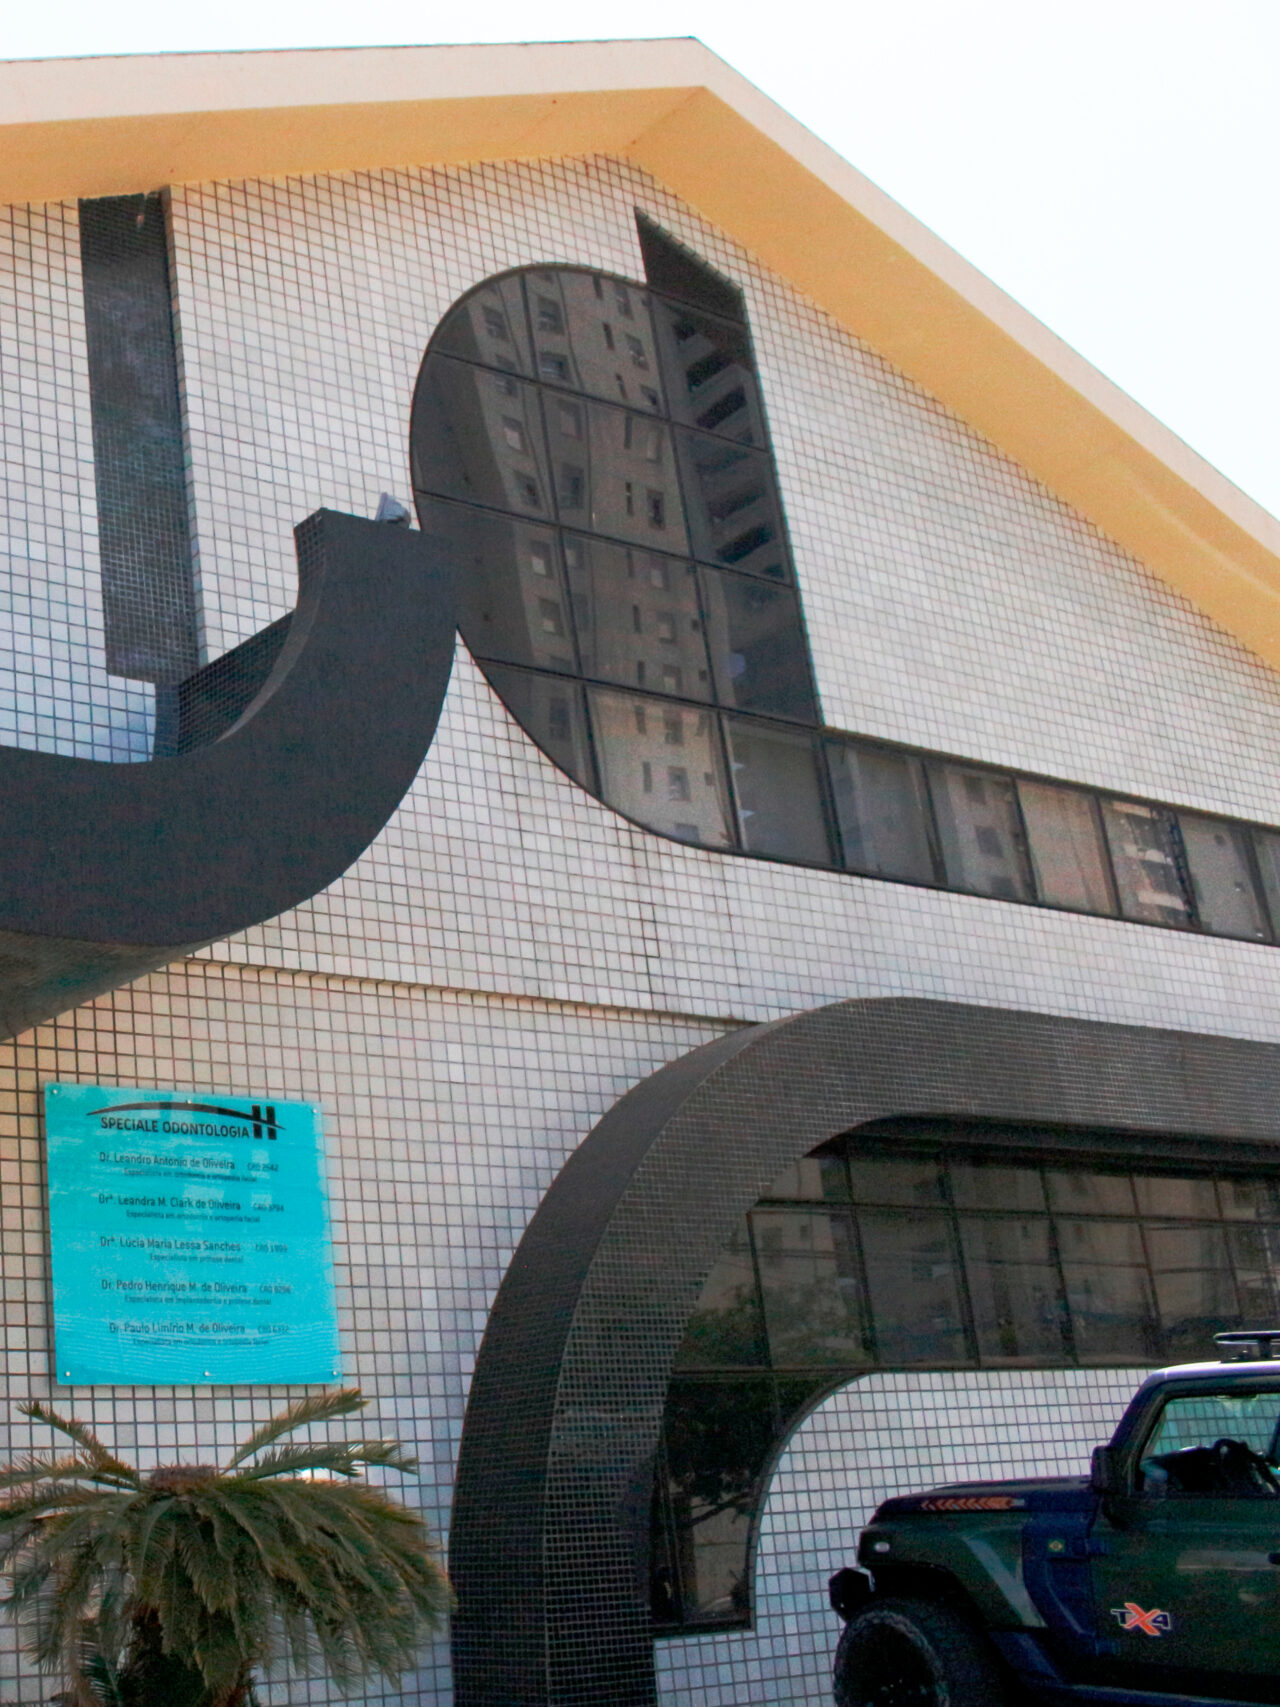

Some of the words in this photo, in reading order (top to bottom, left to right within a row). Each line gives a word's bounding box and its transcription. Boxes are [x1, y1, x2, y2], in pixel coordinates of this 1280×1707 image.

[100, 1116, 159, 1134] SPECIALE
[162, 1121, 250, 1139] ODONTOLOGIA
[115, 1152, 151, 1165] Leandro
[189, 1157, 200, 1168] de
[202, 1157, 235, 1170] Oliveira
[118, 1197, 156, 1207] Leandra
[157, 1197, 168, 1207] M.
[195, 1199, 206, 1209] de
[208, 1200, 241, 1211] Oliveira
[147, 1238, 172, 1249] Maria
[174, 1239, 201, 1250] Lessa
[203, 1240, 241, 1252] Sanches
[116, 1279, 143, 1291] Pedro
[145, 1280, 186, 1293] Henrique
[201, 1281, 212, 1292] de
[214, 1282, 248, 1293] Oliveira
[124, 1322, 150, 1333] Paulo
[198, 1322, 210, 1333] de
[212, 1323, 245, 1334] Oliveira
